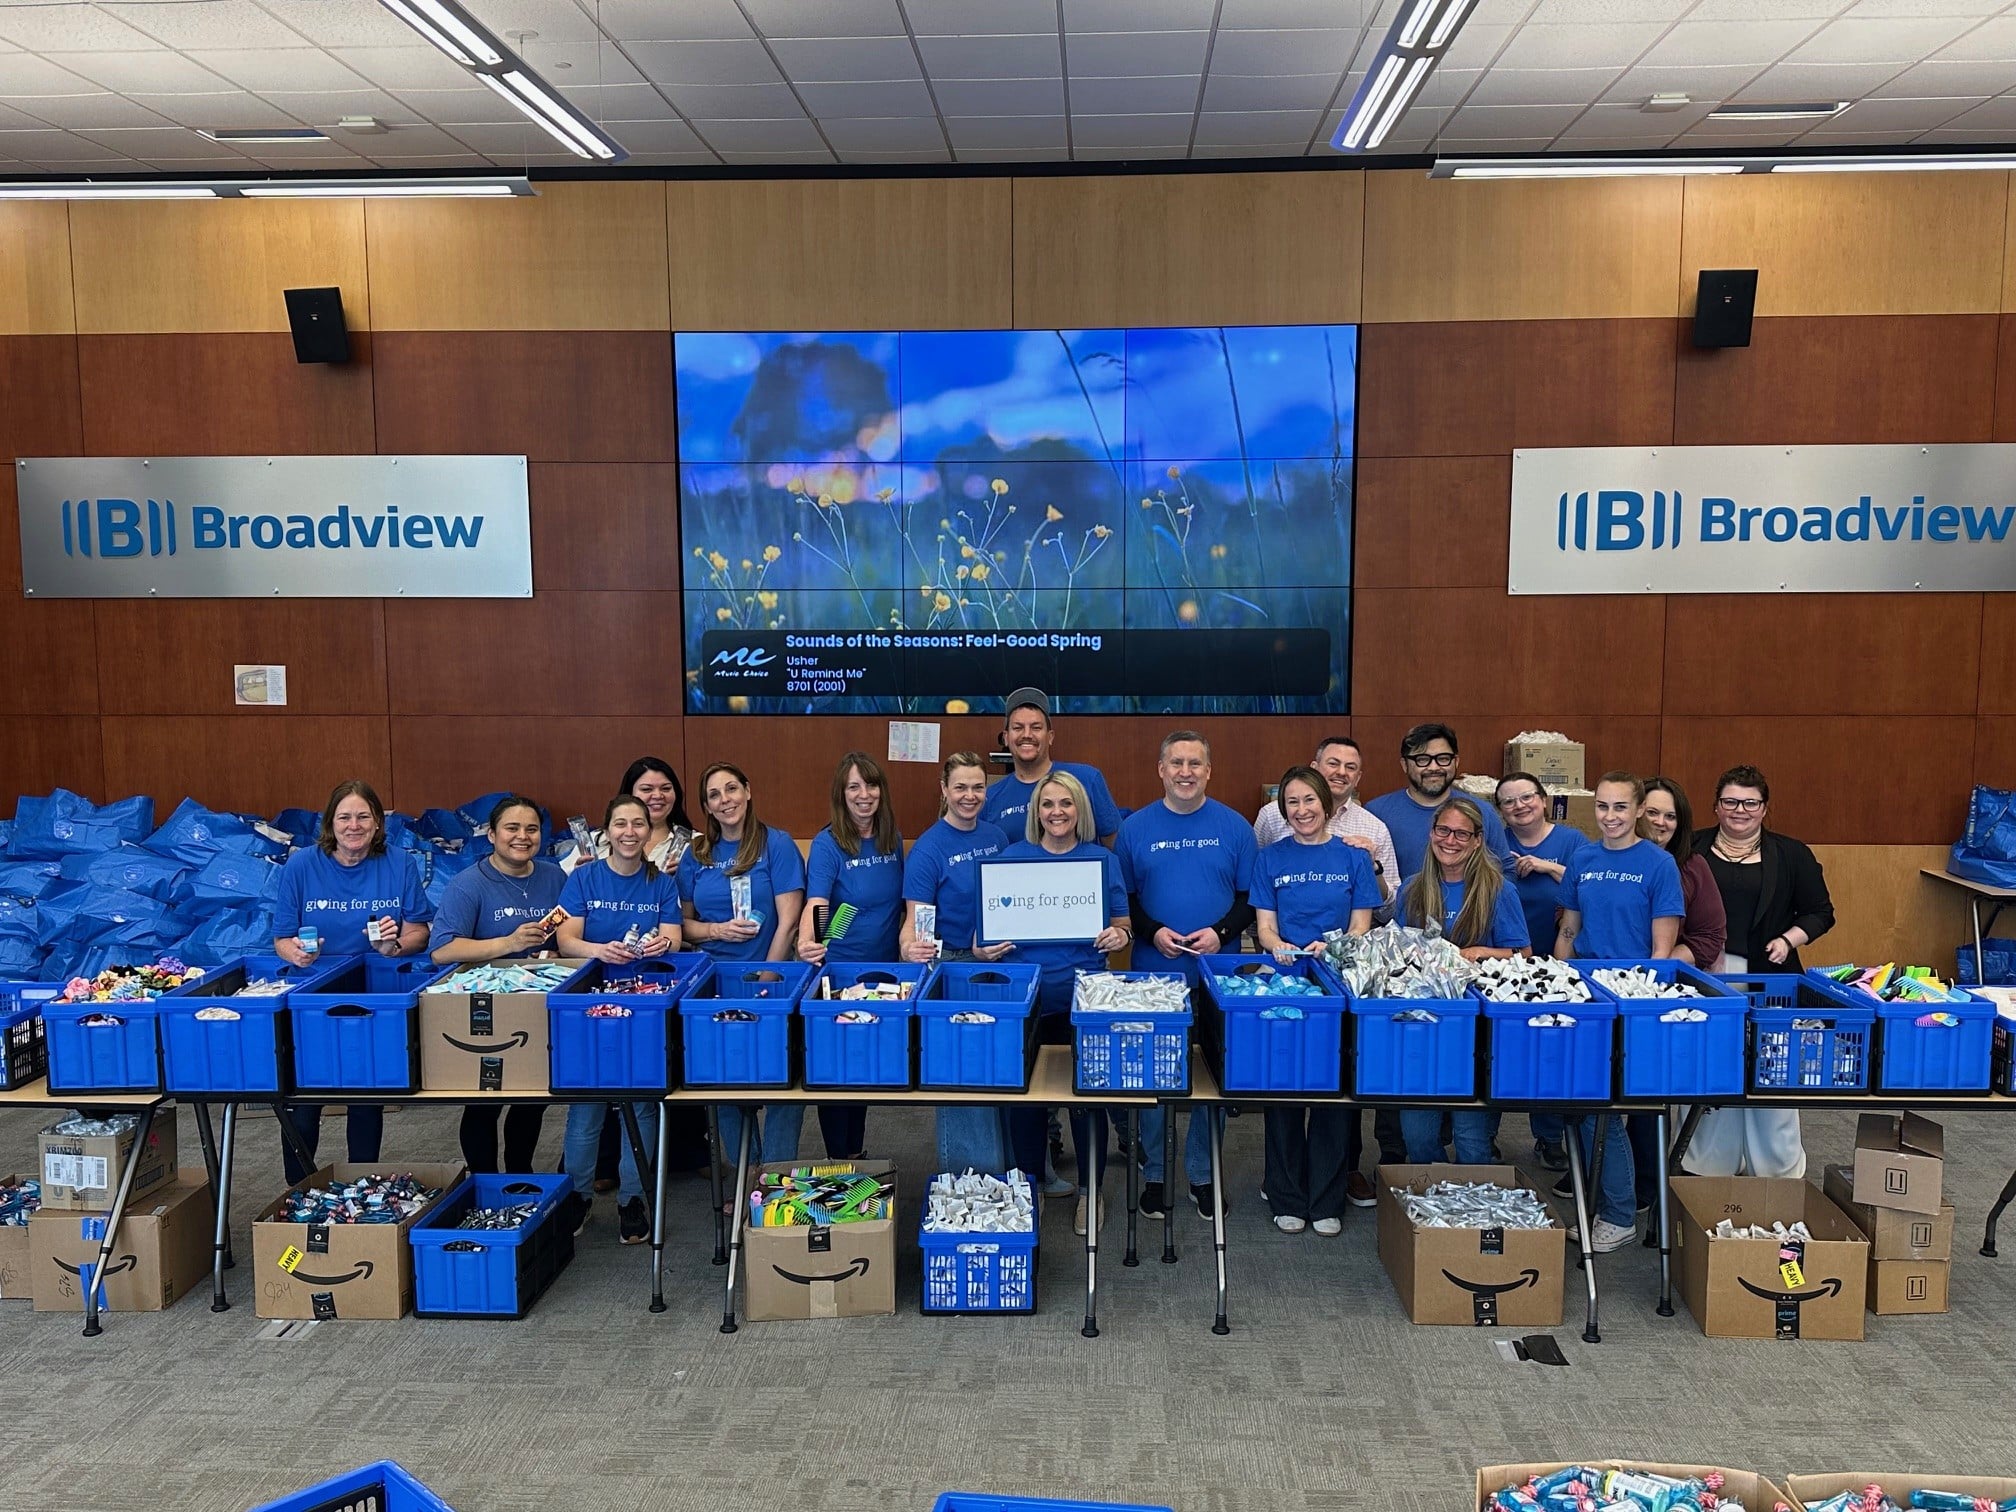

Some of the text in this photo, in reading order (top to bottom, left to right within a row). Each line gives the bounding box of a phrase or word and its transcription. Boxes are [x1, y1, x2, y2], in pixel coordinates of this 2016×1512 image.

[1700, 496, 2015, 542] Broadview
[192, 505, 484, 549] Broadview
[786, 632, 1102, 651] Sounds of the Seasons: Feel-Good Spring
[786, 656, 819, 666] Usher
[801, 668, 843, 679] Remind
[786, 680, 846, 693] 8701 (2001)
[1182, 838, 1196, 848] for
[1197, 837, 1219, 848] good
[973, 848, 983, 857] for
[871, 855, 882, 864] for
[1308, 870, 1324, 881] for
[1325, 873, 1349, 884] good
[1605, 869, 1619, 880] for
[1619, 873, 1643, 884] good
[350, 898, 369, 910] for
[371, 897, 401, 911] good
[1039, 893, 1059, 906] for
[1062, 892, 1096, 908] good
[529, 907, 546, 918] for
[619, 901, 635, 911] for
[637, 903, 660, 913] good
[1724, 1204, 1742, 1213] 296
[282, 1249, 300, 1269] HEAVY
[1785, 1263, 1800, 1286] HEAVY
